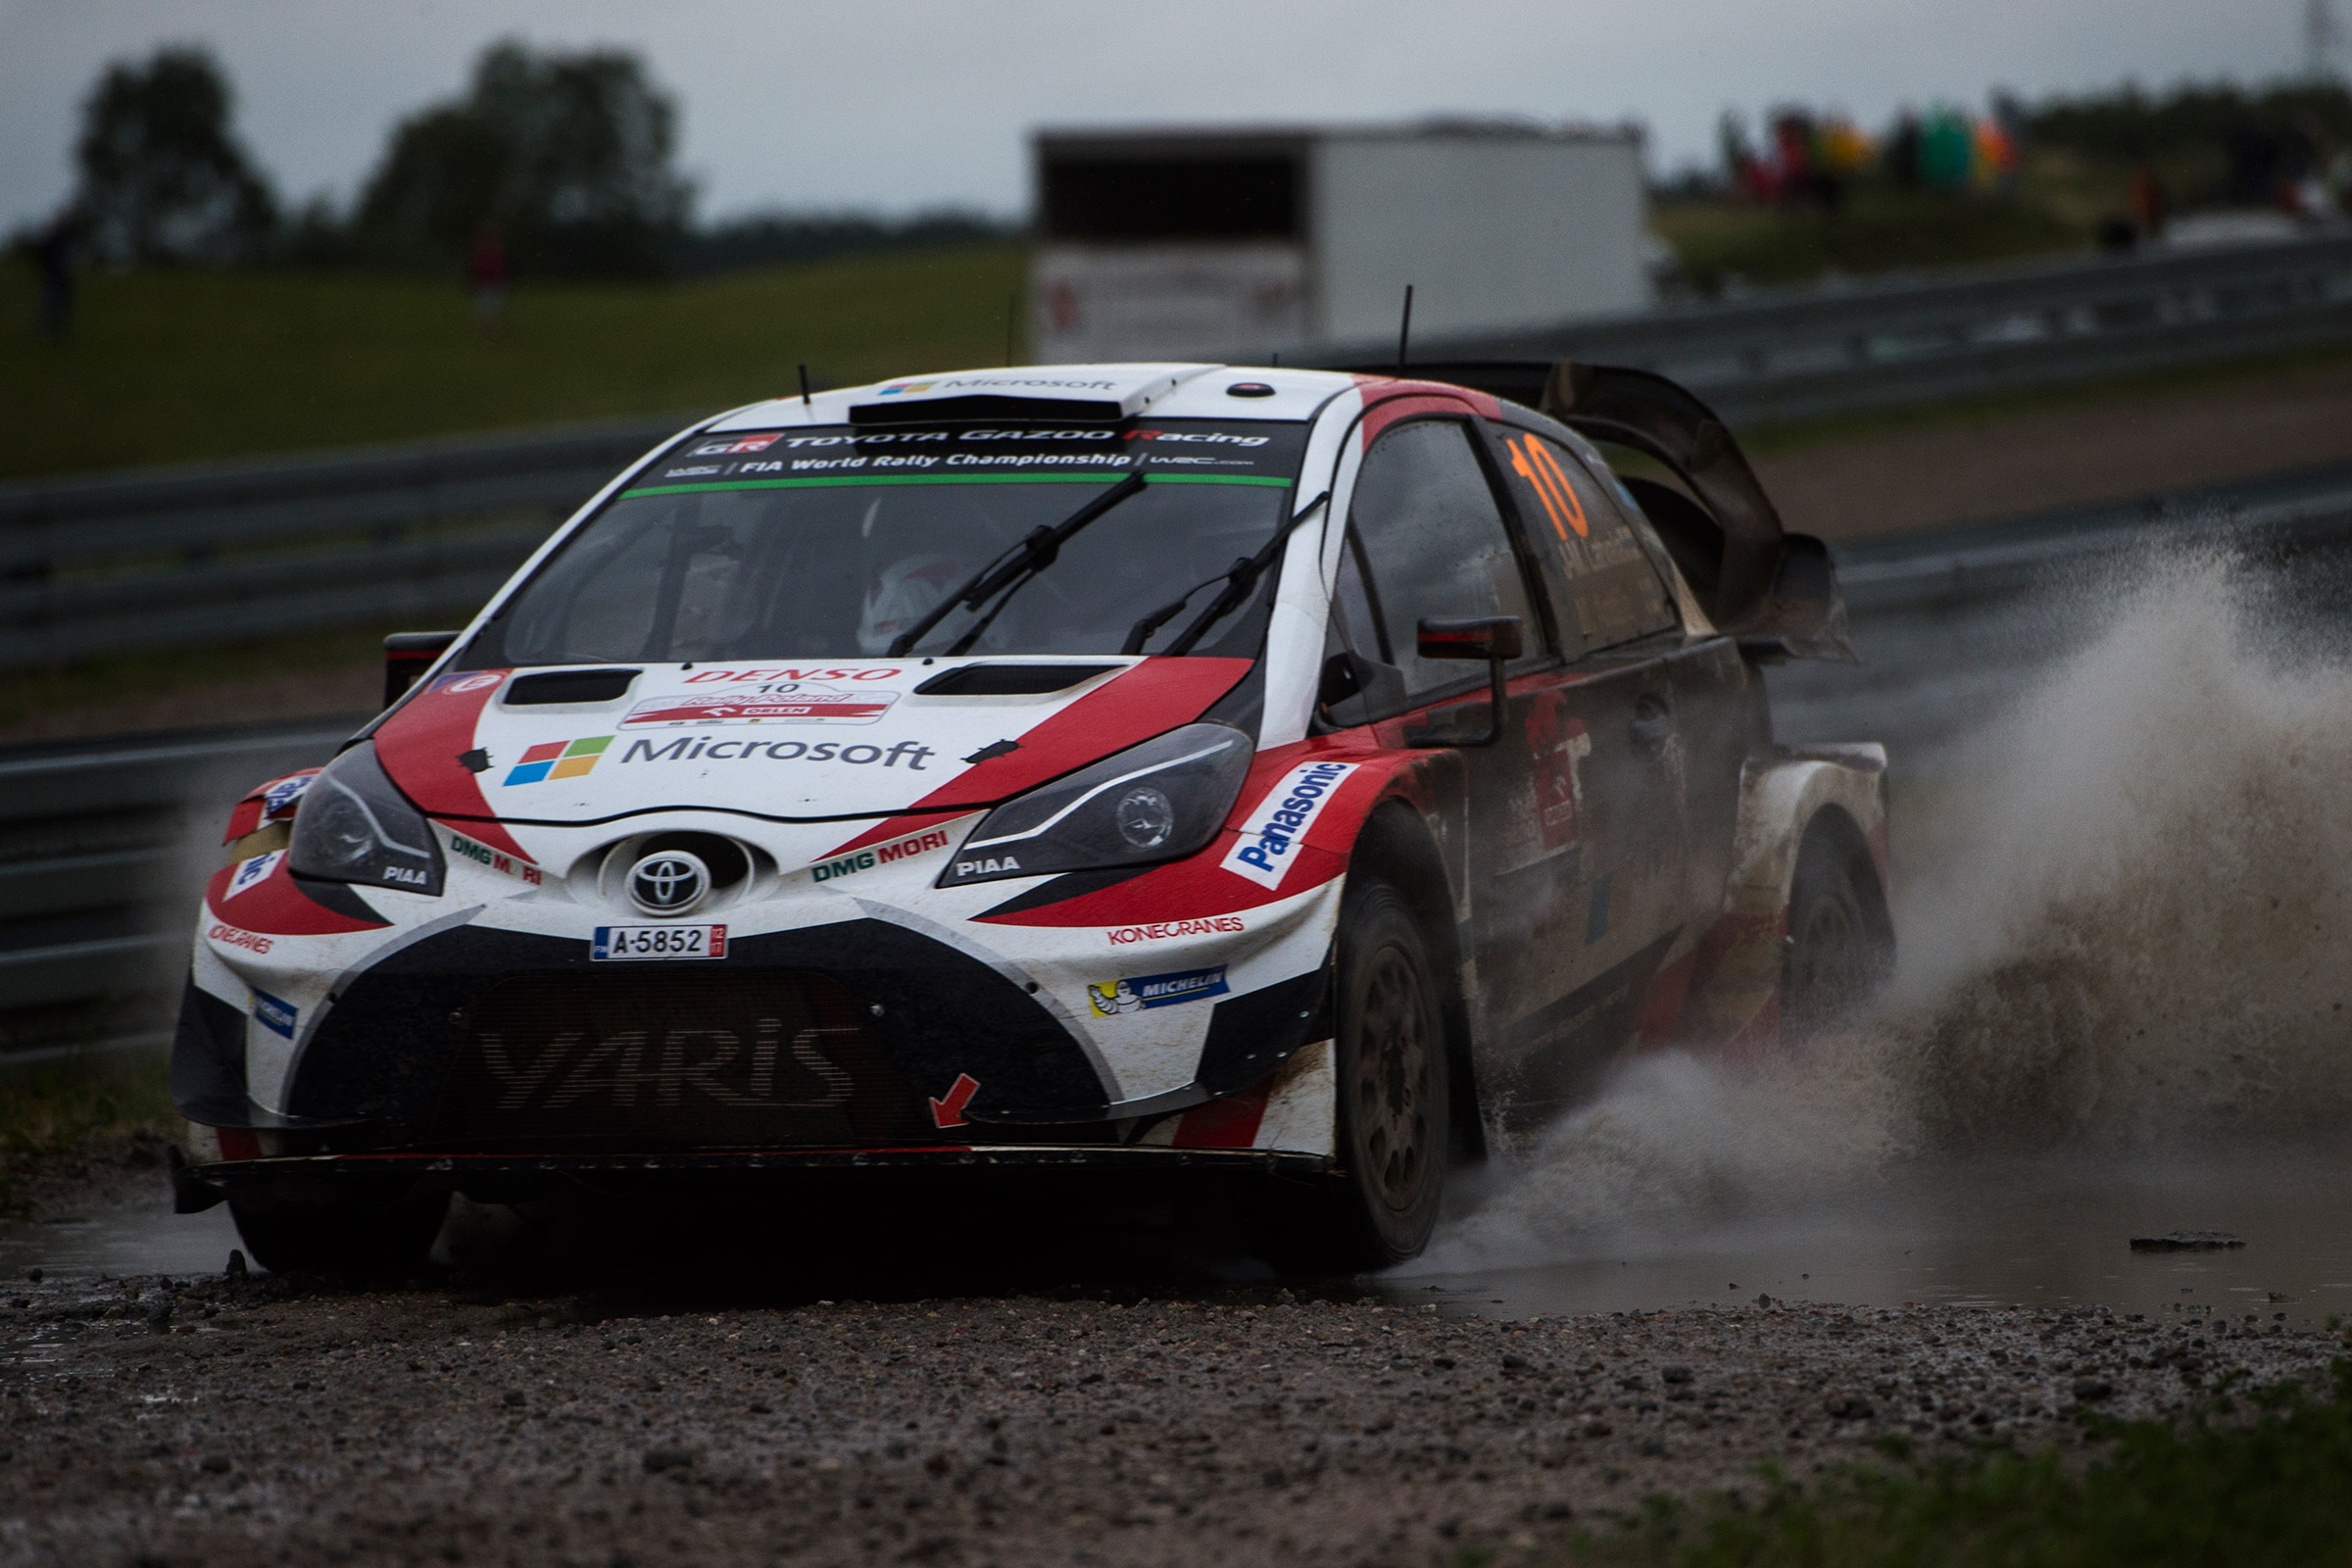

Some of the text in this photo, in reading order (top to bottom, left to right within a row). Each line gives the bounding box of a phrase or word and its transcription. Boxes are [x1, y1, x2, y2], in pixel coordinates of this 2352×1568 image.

[944, 379, 1116, 390] Microsoft
[786, 429, 1270, 447] TOYOTA GAZOO Racing
[695, 442, 768, 455] GR
[740, 453, 1131, 472] FIA World Rally Championship
[1506, 433, 1589, 541] 10
[682, 668, 902, 684] DENSO
[759, 683, 800, 694] 10
[748, 706, 806, 714] ORLEN
[620, 736, 936, 770] Microsoft
[1237, 762, 1348, 872] Panasonic
[450, 835, 542, 886] DMG MRI
[810, 830, 949, 882] DMG MORI
[383, 865, 426, 885] PIAA
[956, 856, 1020, 877] PIAA
[1106, 916, 1244, 946] KONECRANES
[1142, 971, 1224, 998] MICHELIN
